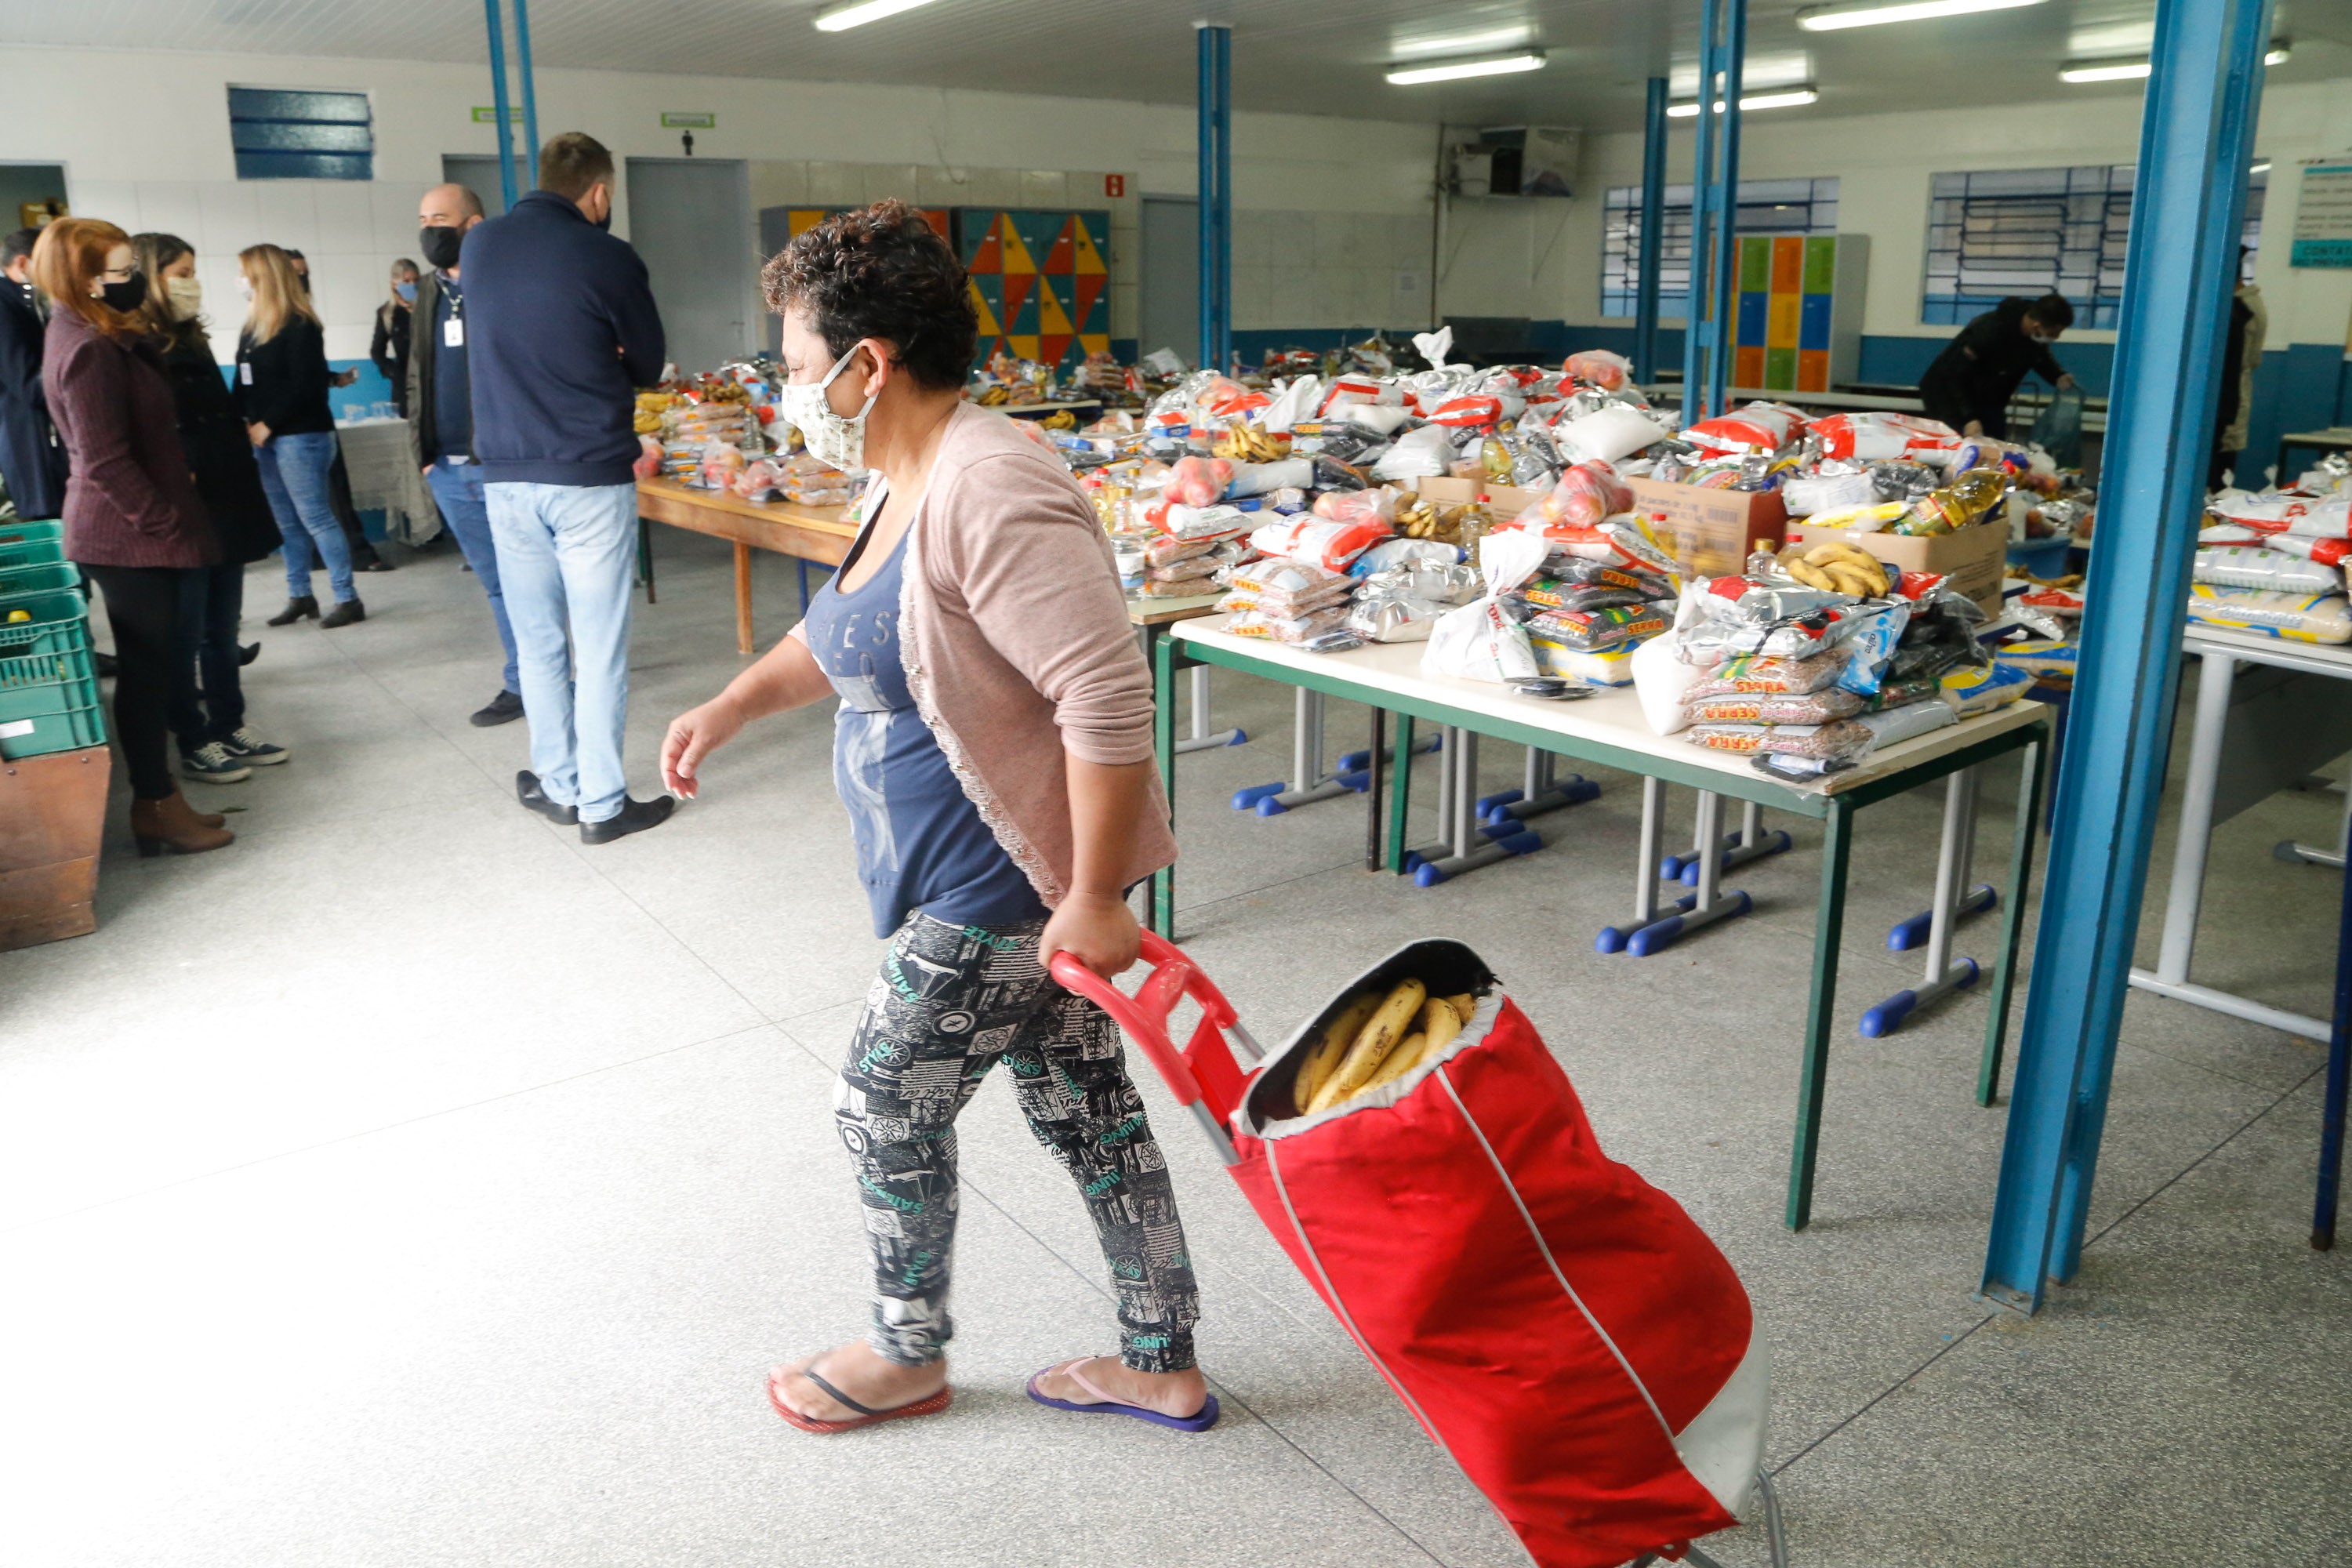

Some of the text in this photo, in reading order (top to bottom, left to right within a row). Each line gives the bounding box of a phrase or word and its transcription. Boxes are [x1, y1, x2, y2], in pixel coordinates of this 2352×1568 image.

[1601, 569, 1641, 588] SERRA
[1526, 590, 1563, 607] SERRA
[1626, 619, 1664, 635] SERRA
[1735, 681, 1788, 693] SERRA
[1705, 706, 1759, 719] SERRA
[1708, 736, 1759, 750] SERRA
[859, 1043, 892, 1073] STYLE
